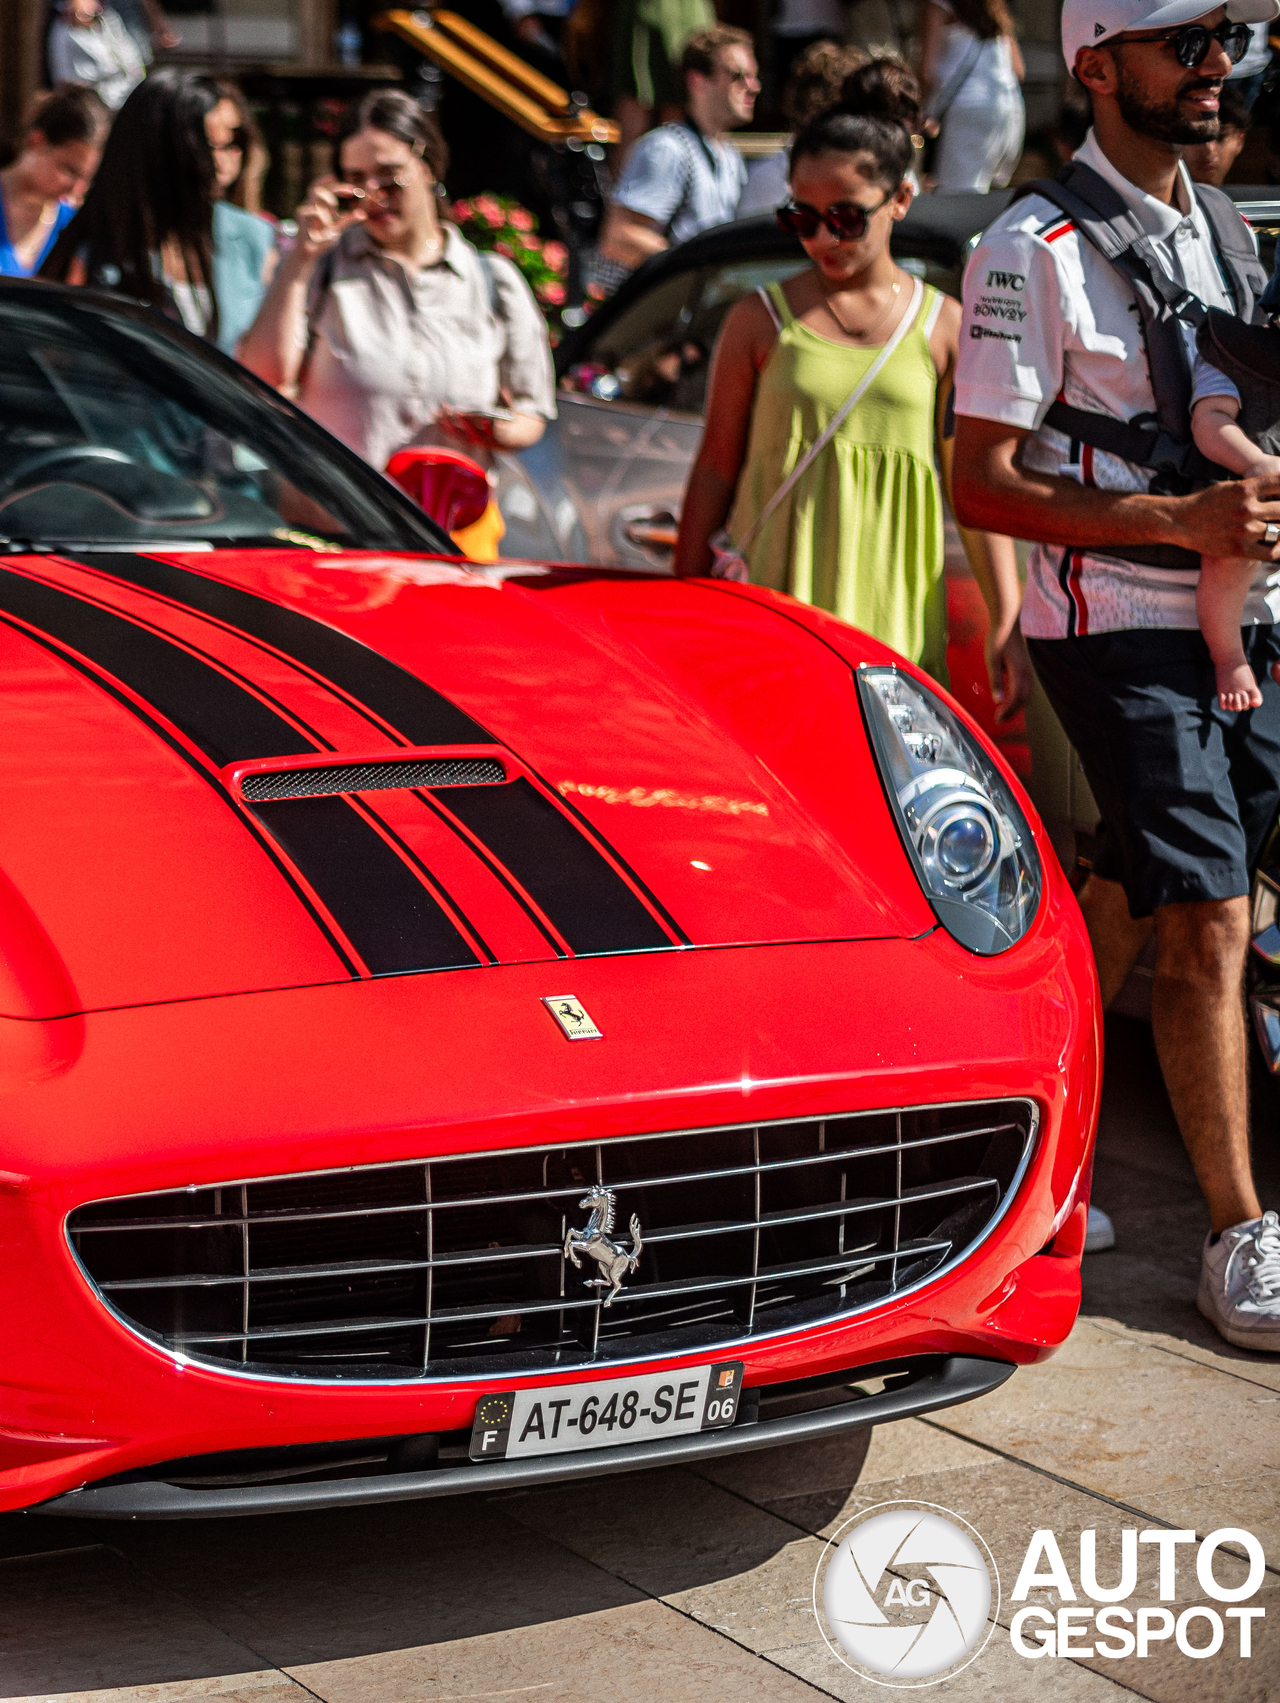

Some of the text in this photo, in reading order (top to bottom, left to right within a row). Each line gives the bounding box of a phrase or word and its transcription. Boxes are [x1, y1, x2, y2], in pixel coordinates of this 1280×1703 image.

[985, 270, 1025, 291] IWC
[973, 303, 1027, 322] BONVOY
[518, 1380, 699, 1442] AT-648-SE
[707, 1398, 735, 1420] 06
[481, 1430, 498, 1450] F
